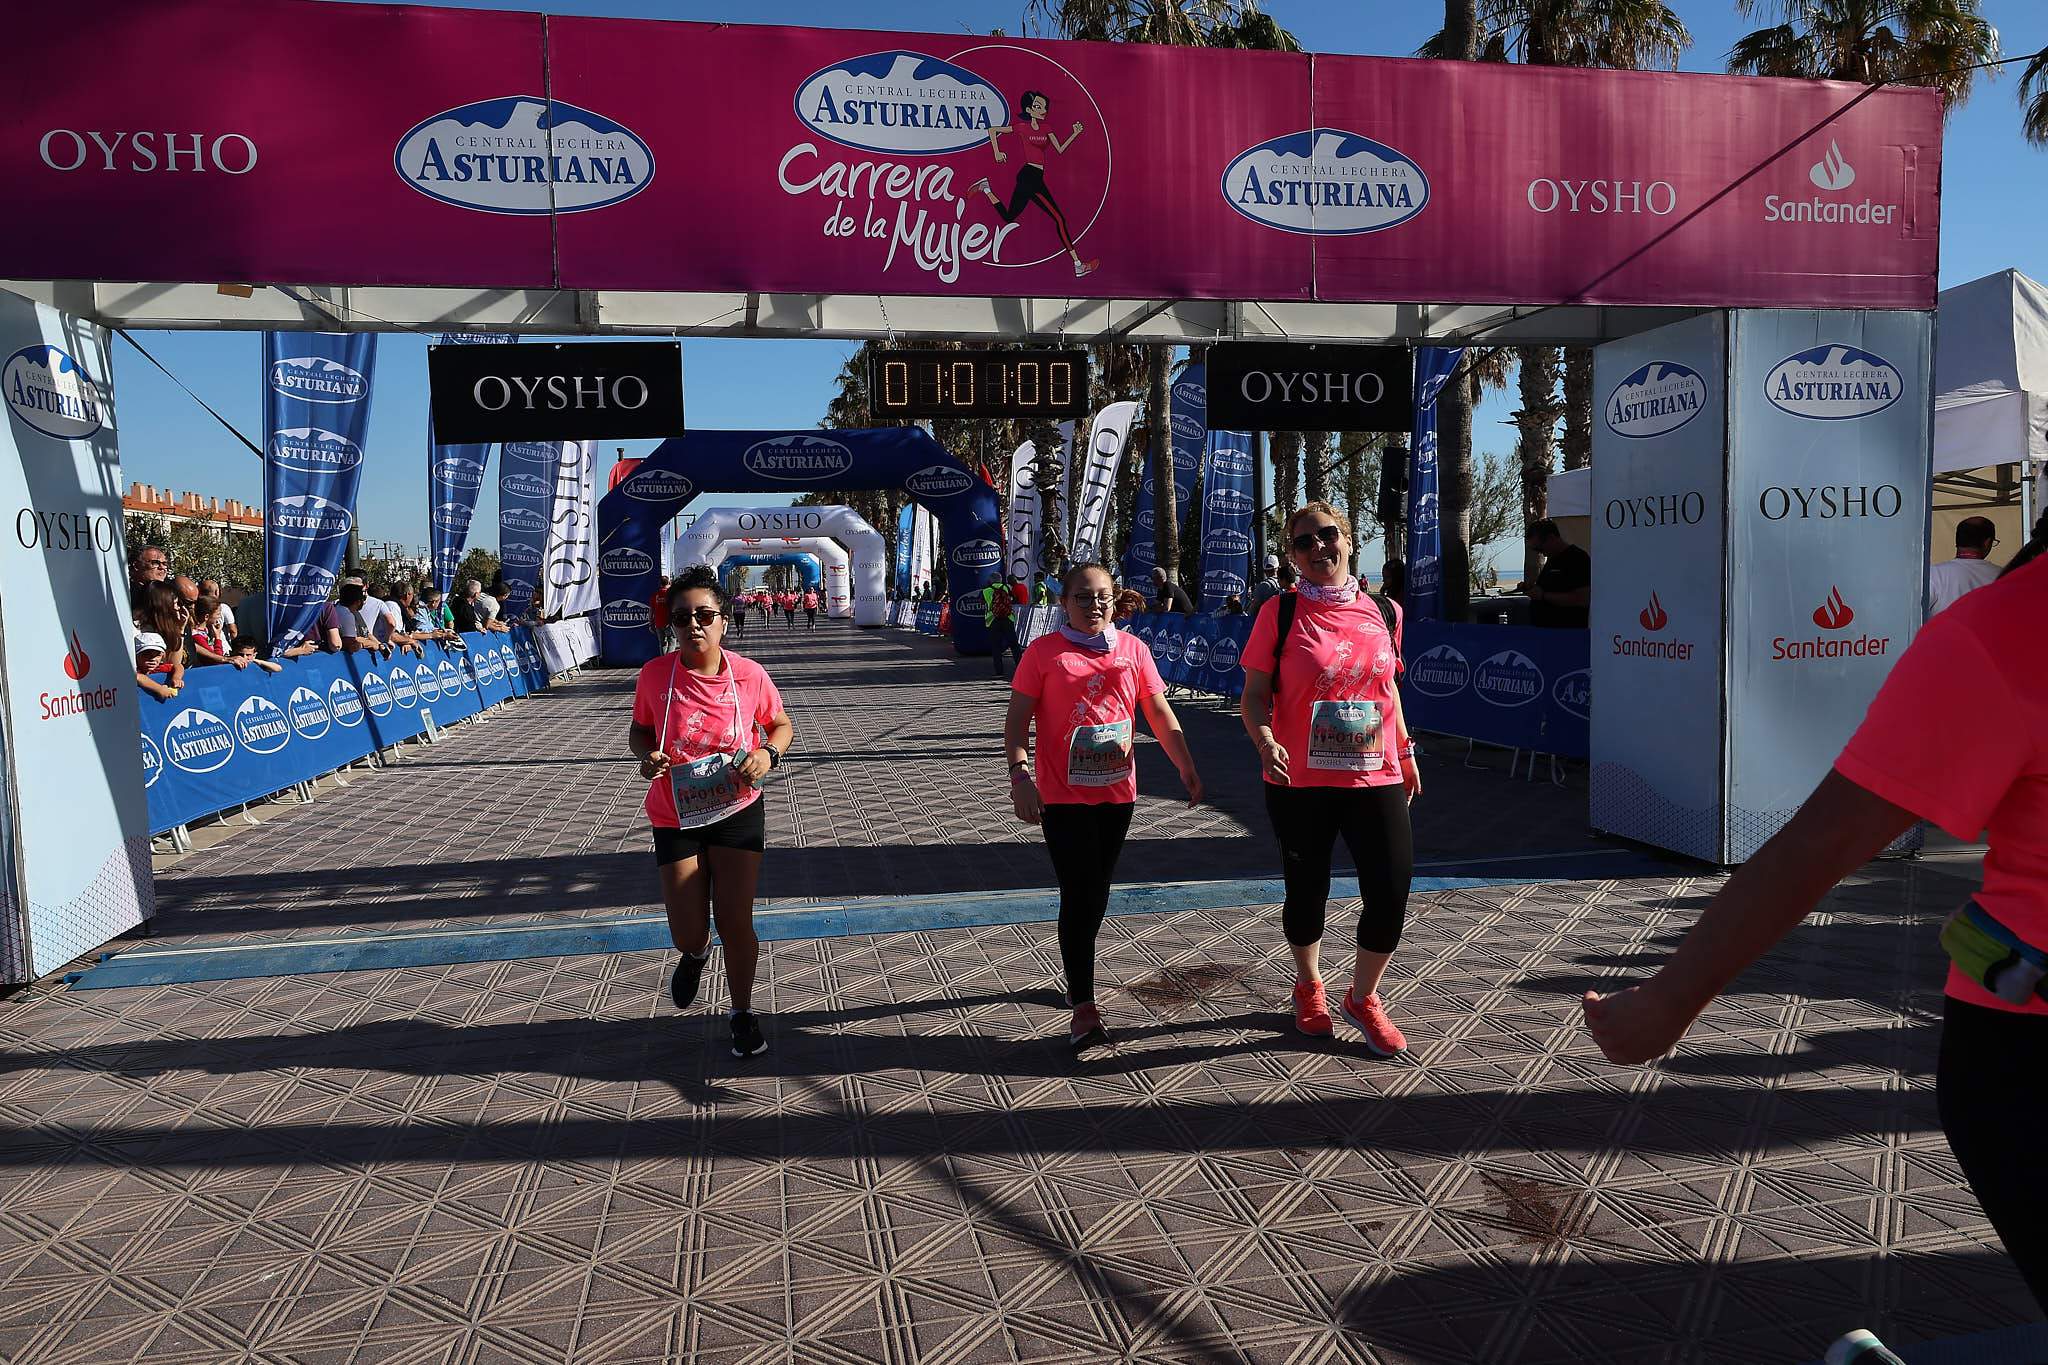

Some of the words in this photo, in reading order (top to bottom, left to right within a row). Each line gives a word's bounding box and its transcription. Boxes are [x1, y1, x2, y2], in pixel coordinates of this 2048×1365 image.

[845, 84, 912, 97] CENTRAL
[919, 87, 986, 100] LECHERA
[812, 85, 992, 130] ASTURIANA
[39, 129, 258, 174] OYSHO
[455, 136, 536, 148] CENTRAL
[416, 138, 636, 184] ASTURIANA
[778, 142, 956, 200] Carrera
[1271, 164, 1335, 176] CENTRAL
[1342, 166, 1407, 177] LECHERA
[1238, 165, 1414, 208] ASTURIANA
[1527, 177, 1677, 215] OYSHO
[1764, 194, 1897, 225] Santander
[823, 200, 856, 237] de
[863, 201, 887, 239] la
[883, 198, 1020, 283] Mujer
[275, 368, 361, 395] ASTURIANA
[1241, 371, 1384, 404] OYSHO
[1774, 372, 1893, 400] ASTURIANA
[1796, 371, 1839, 379] CENTRAL
[1844, 370, 1888, 378] LECHERA
[12, 369, 99, 423] ASTURIANA
[474, 375, 648, 410] OYSHO
[1626, 388, 1657, 400] CENTRAL
[1612, 391, 1698, 425] ASTURIANA
[752, 449, 845, 469] ASTURIANA
[627, 482, 687, 494] ASTURIANA
[912, 478, 969, 490] ASTURIANA
[1606, 491, 1705, 530] OYSHO
[1759, 484, 1902, 520] OYSHO
[16, 508, 113, 553] OYSHO
[738, 512, 822, 531] OYSHO
[603, 559, 650, 570] ASTURIANA
[604, 609, 650, 622] ASTURIANA
[1612, 634, 1694, 661] Santander
[1772, 633, 1890, 660] Santander
[1414, 662, 1464, 686] ASTURIANA
[1478, 669, 1536, 696] ASTURIANA
[40, 684, 117, 721] Santander
[240, 719, 288, 744] ASTURIANA
[293, 709, 328, 729] ASTURIANA
[171, 733, 232, 762] ASTURIANA
[178, 731, 201, 741] CENTRAL
